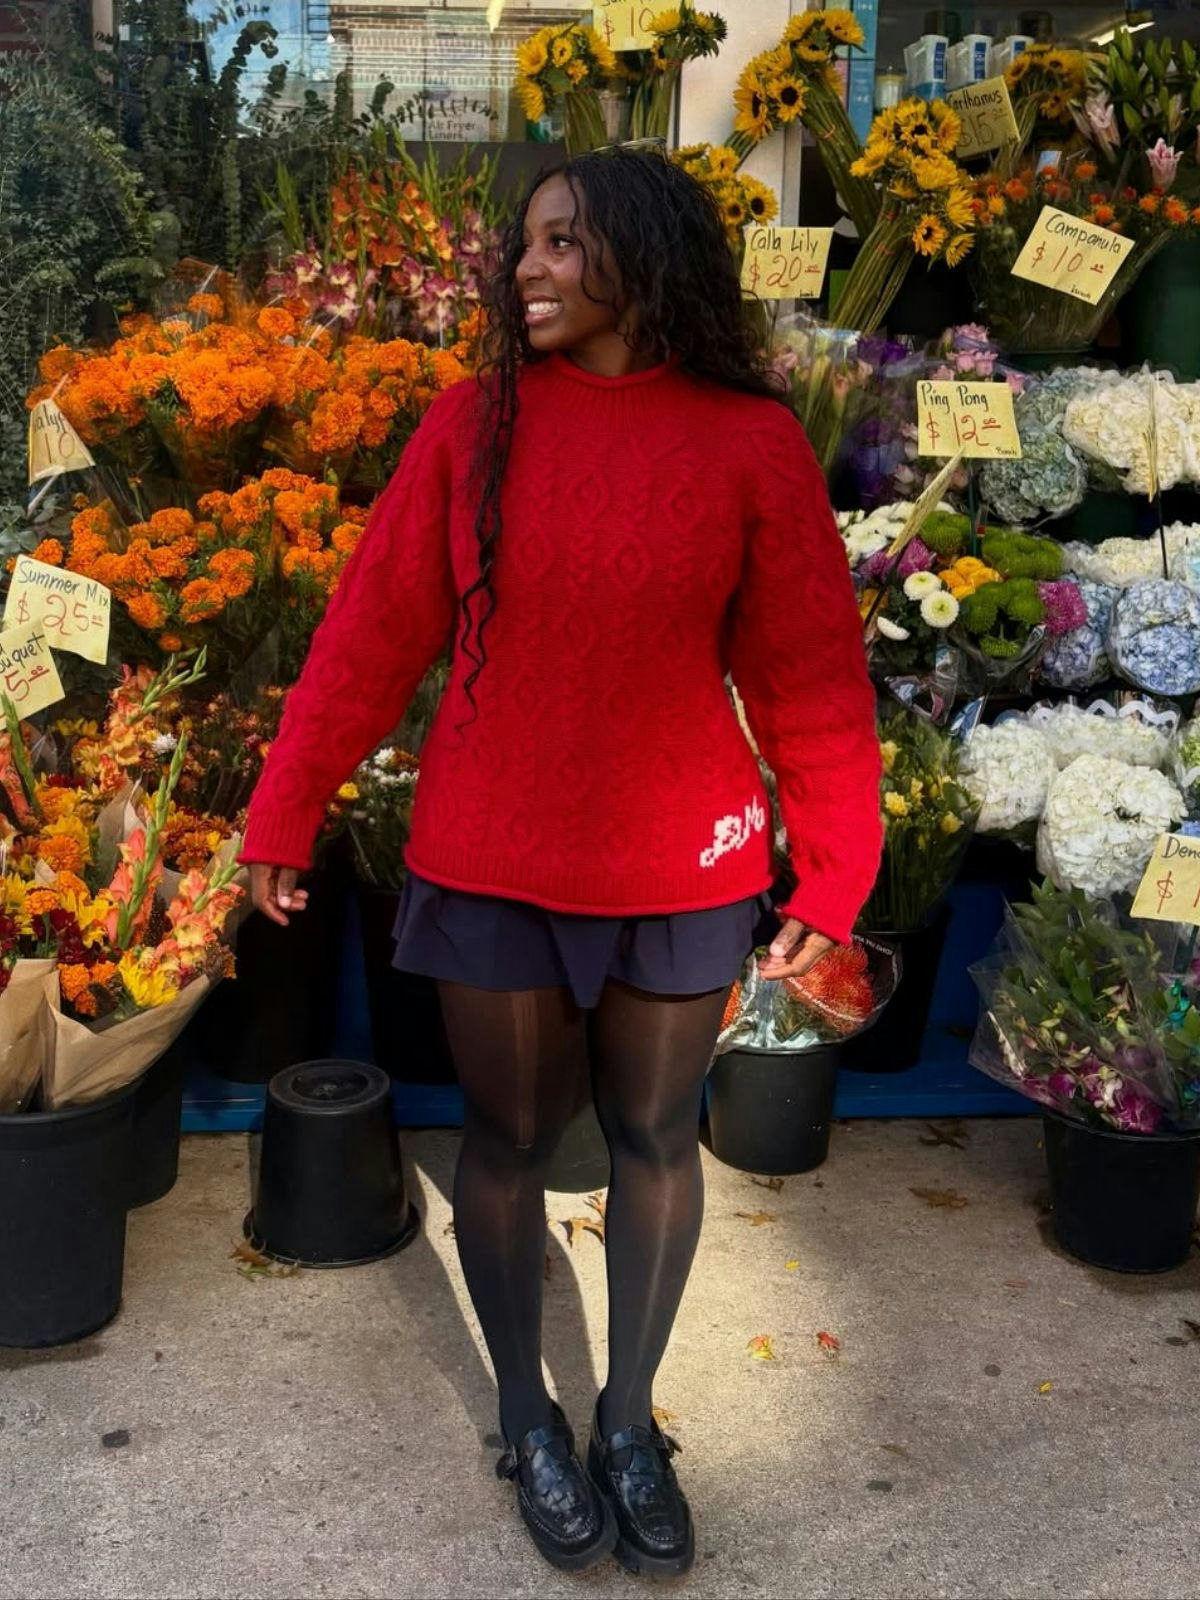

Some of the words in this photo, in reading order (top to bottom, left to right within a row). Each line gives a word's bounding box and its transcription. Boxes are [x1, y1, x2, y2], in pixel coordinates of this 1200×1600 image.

[791, 228, 818, 259] Lily
[1045, 213, 1121, 254] Campanula
[921, 382, 950, 414] Ping
[956, 384, 989, 412] Pong
[44, 432, 75, 464] 10
[18, 560, 80, 595] Summer
[85, 583, 110, 609] Mix
